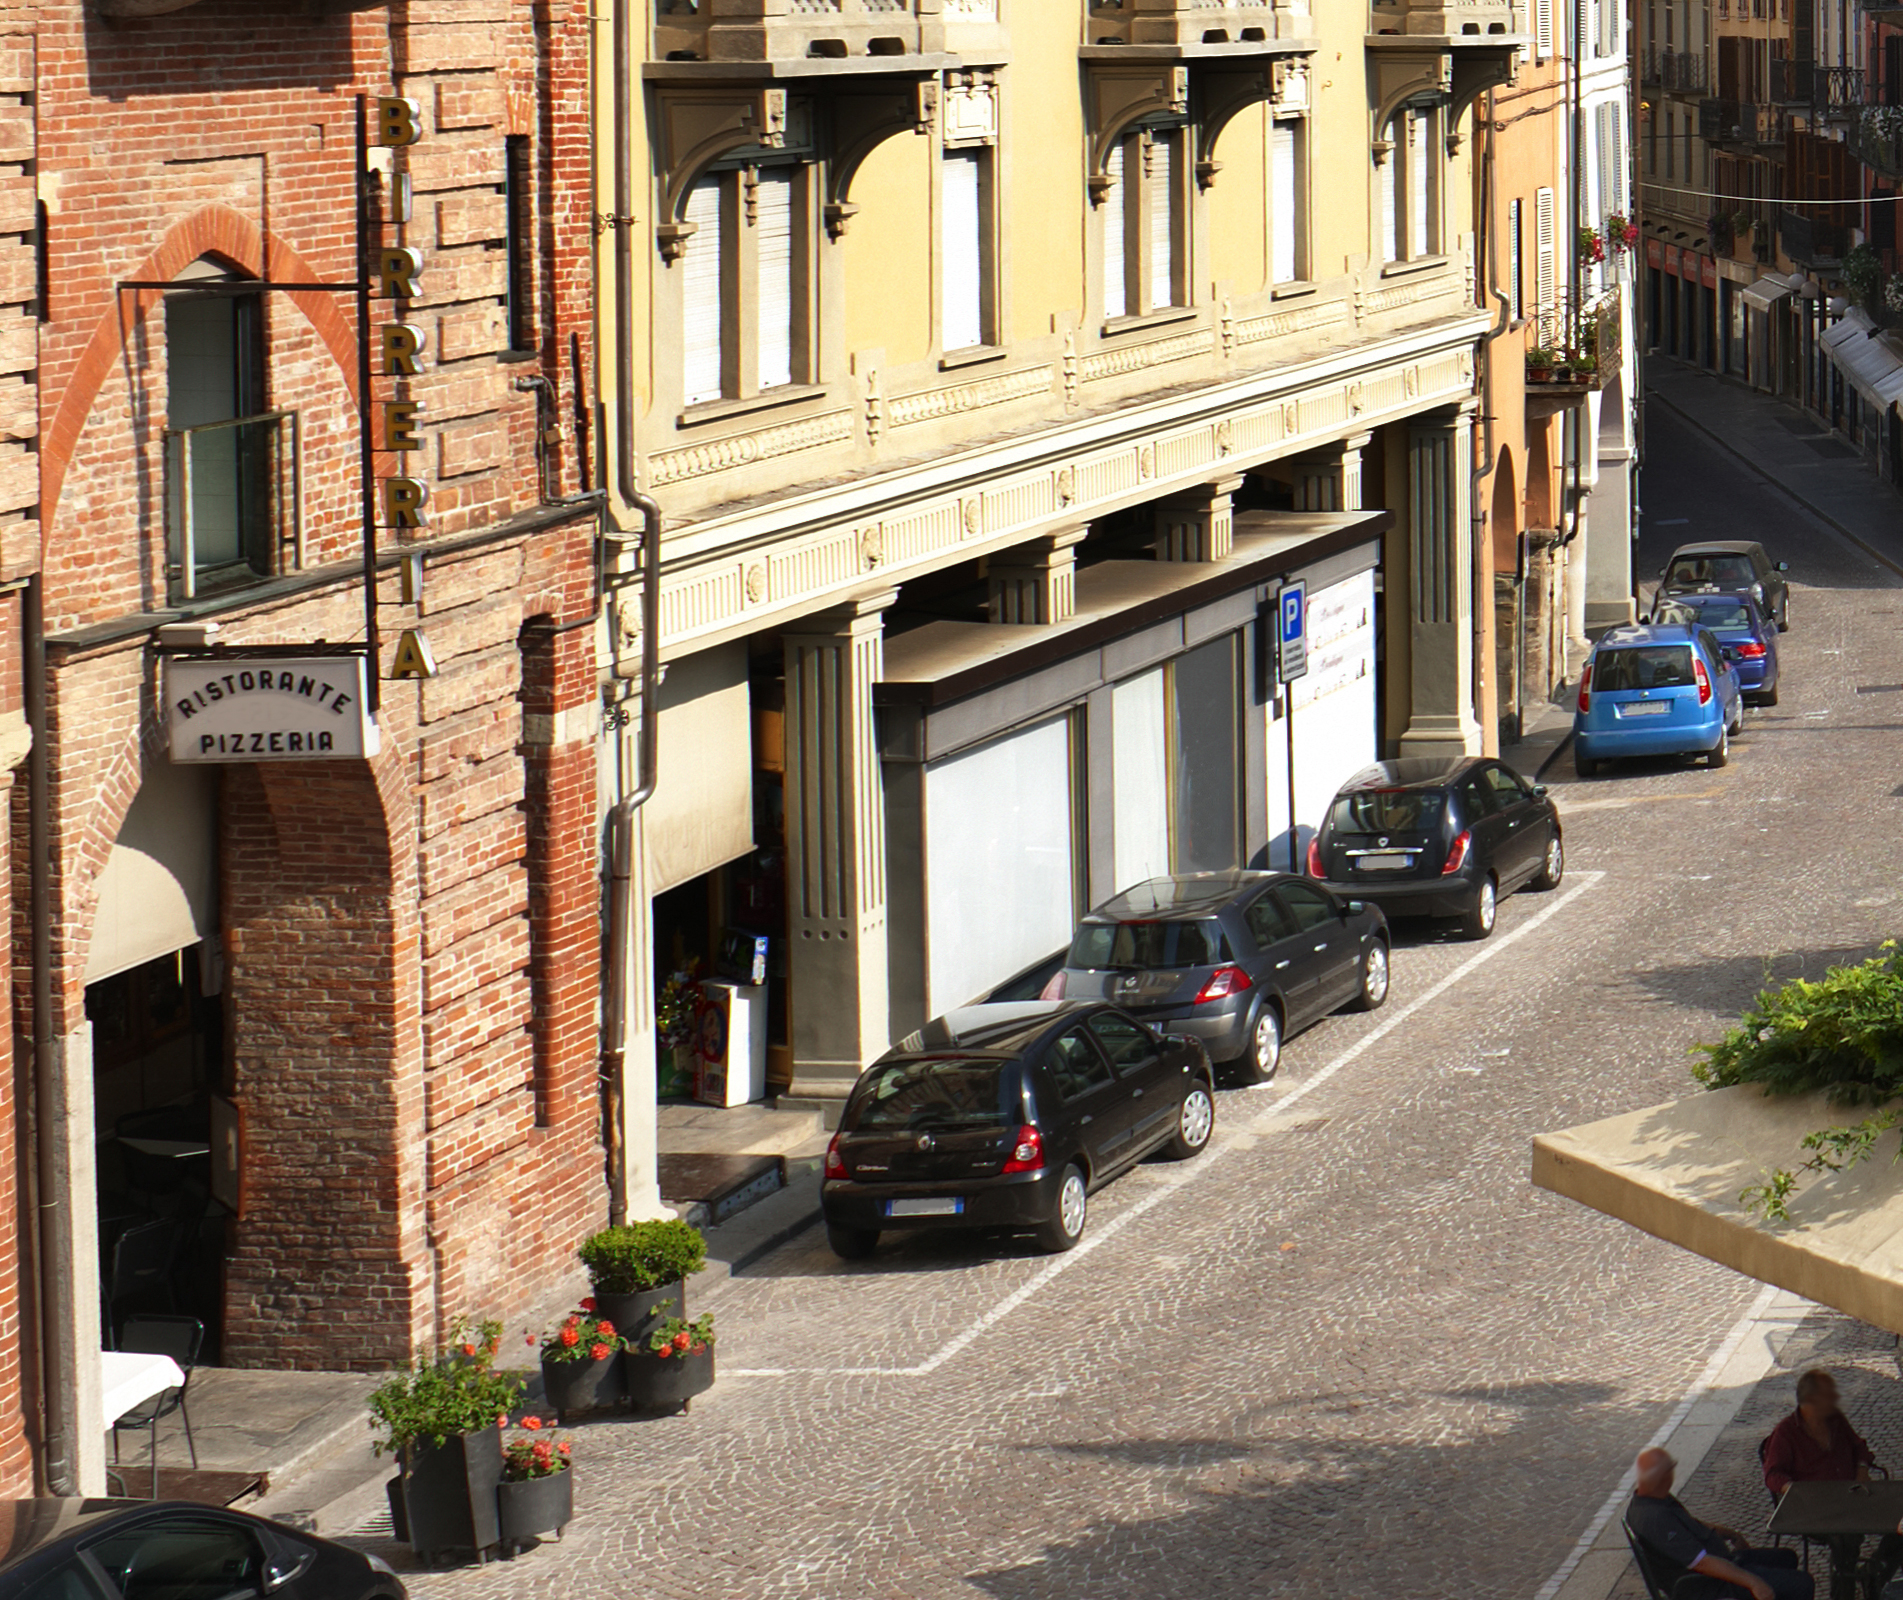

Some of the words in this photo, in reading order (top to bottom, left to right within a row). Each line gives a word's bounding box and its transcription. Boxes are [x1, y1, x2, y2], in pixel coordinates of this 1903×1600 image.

[378, 97, 438, 678] BIRRERIA
[1286, 597, 1299, 636] P
[176, 669, 352, 719] RISTORANTE
[201, 731, 333, 754] PIZZERIA
